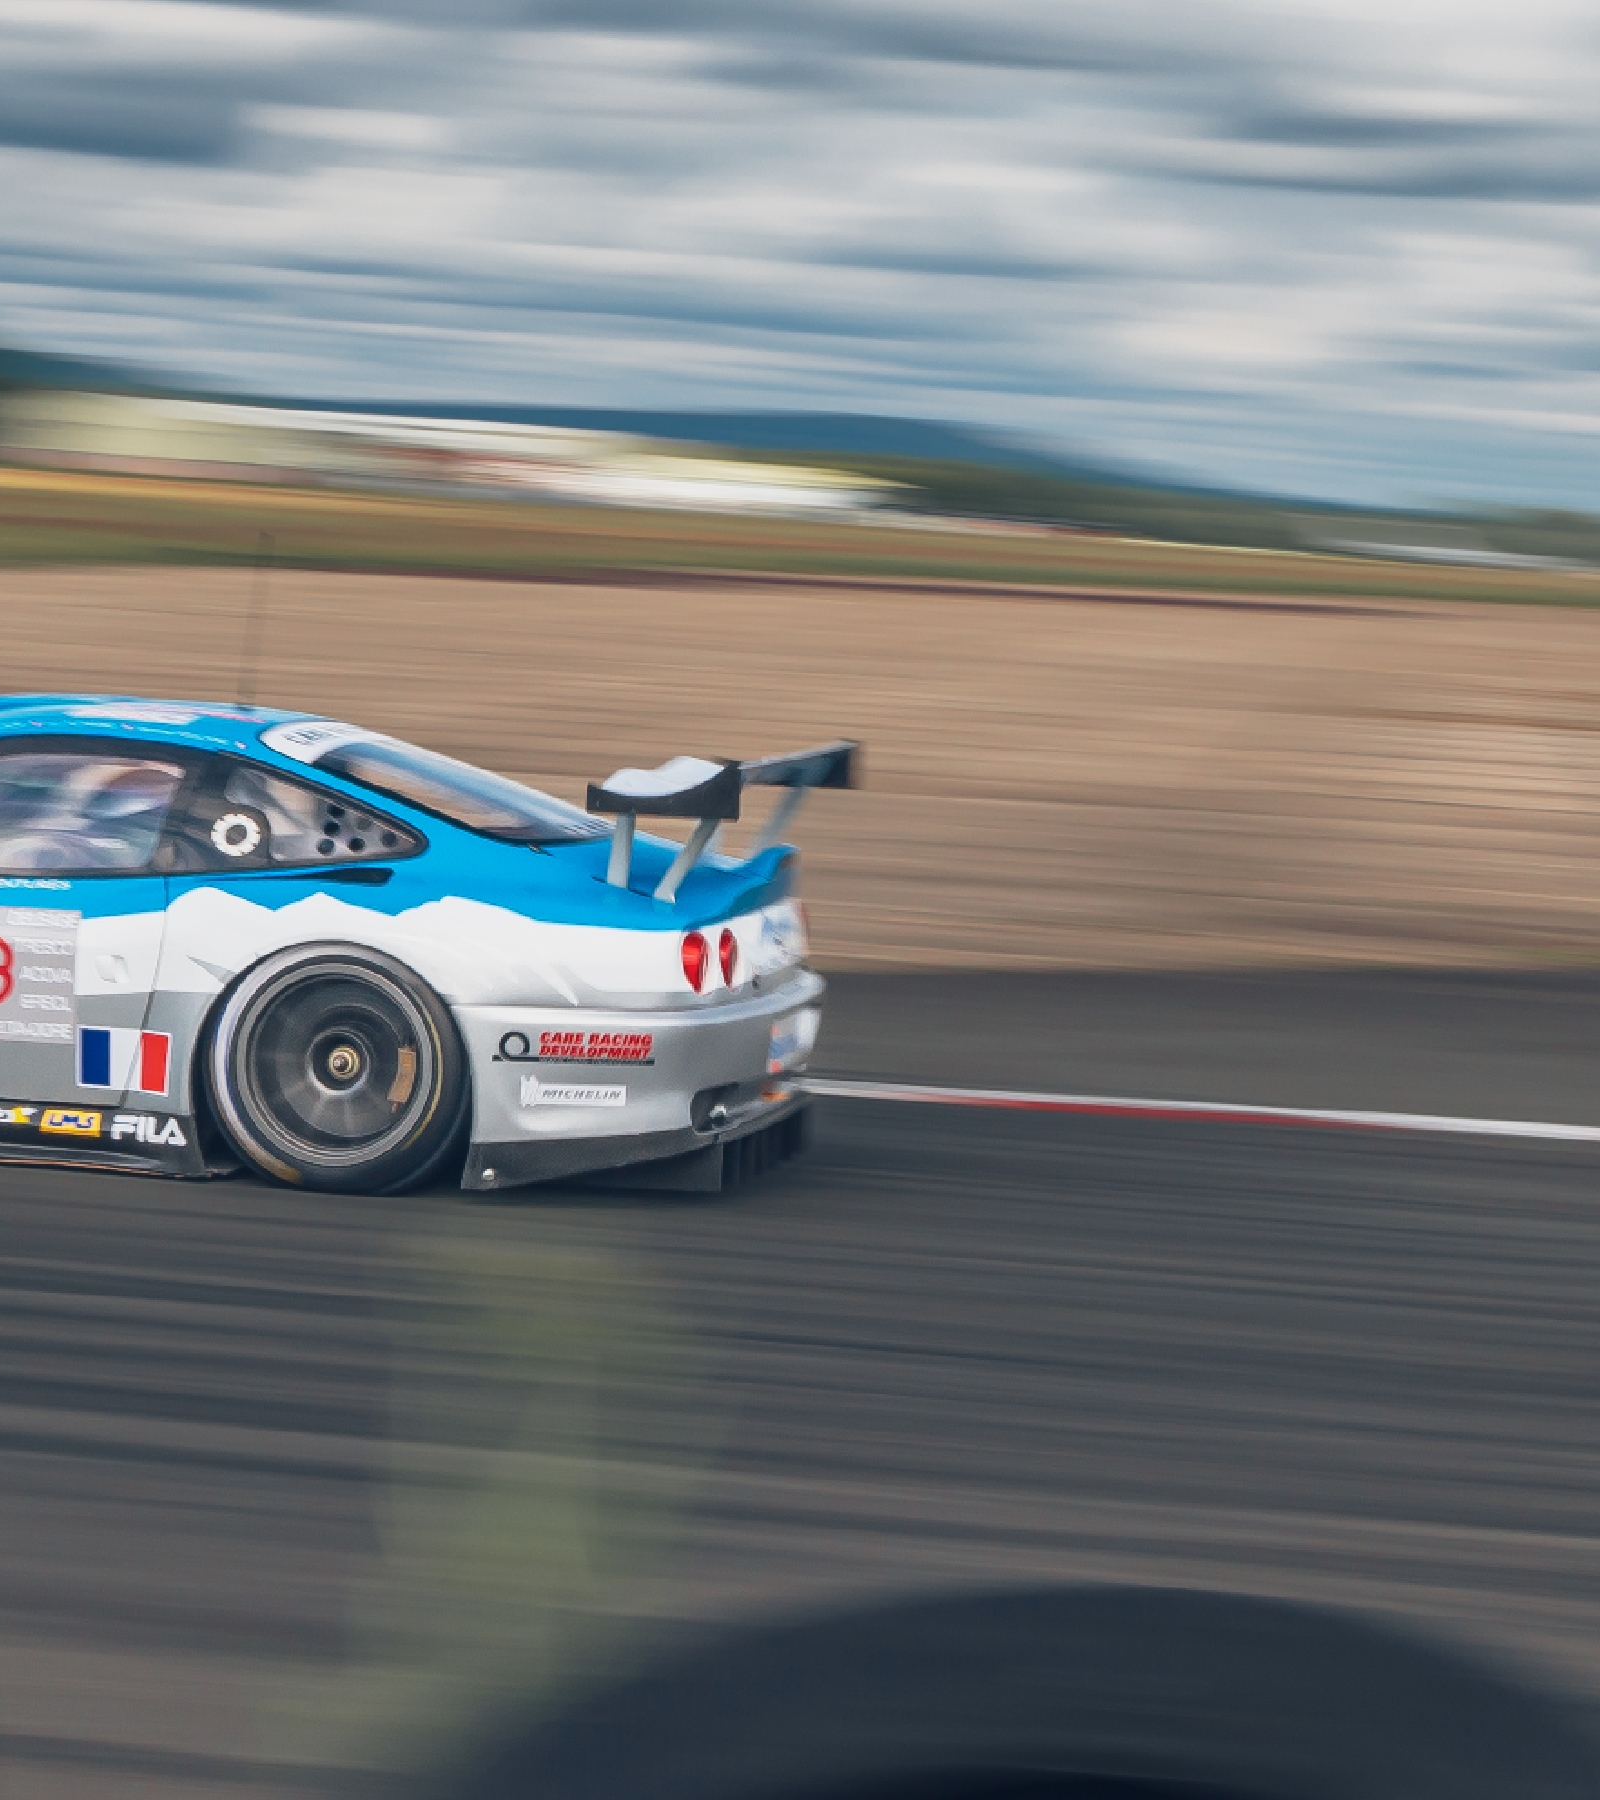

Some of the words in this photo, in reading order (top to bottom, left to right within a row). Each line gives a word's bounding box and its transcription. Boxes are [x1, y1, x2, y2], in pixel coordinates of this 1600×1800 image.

[539, 1030, 585, 1045] CARE
[587, 1032, 653, 1047] RACING
[538, 1045, 651, 1060] DEVELOPMENT
[542, 1089, 622, 1100] MICHELIN
[110, 1114, 187, 1146] FILA
